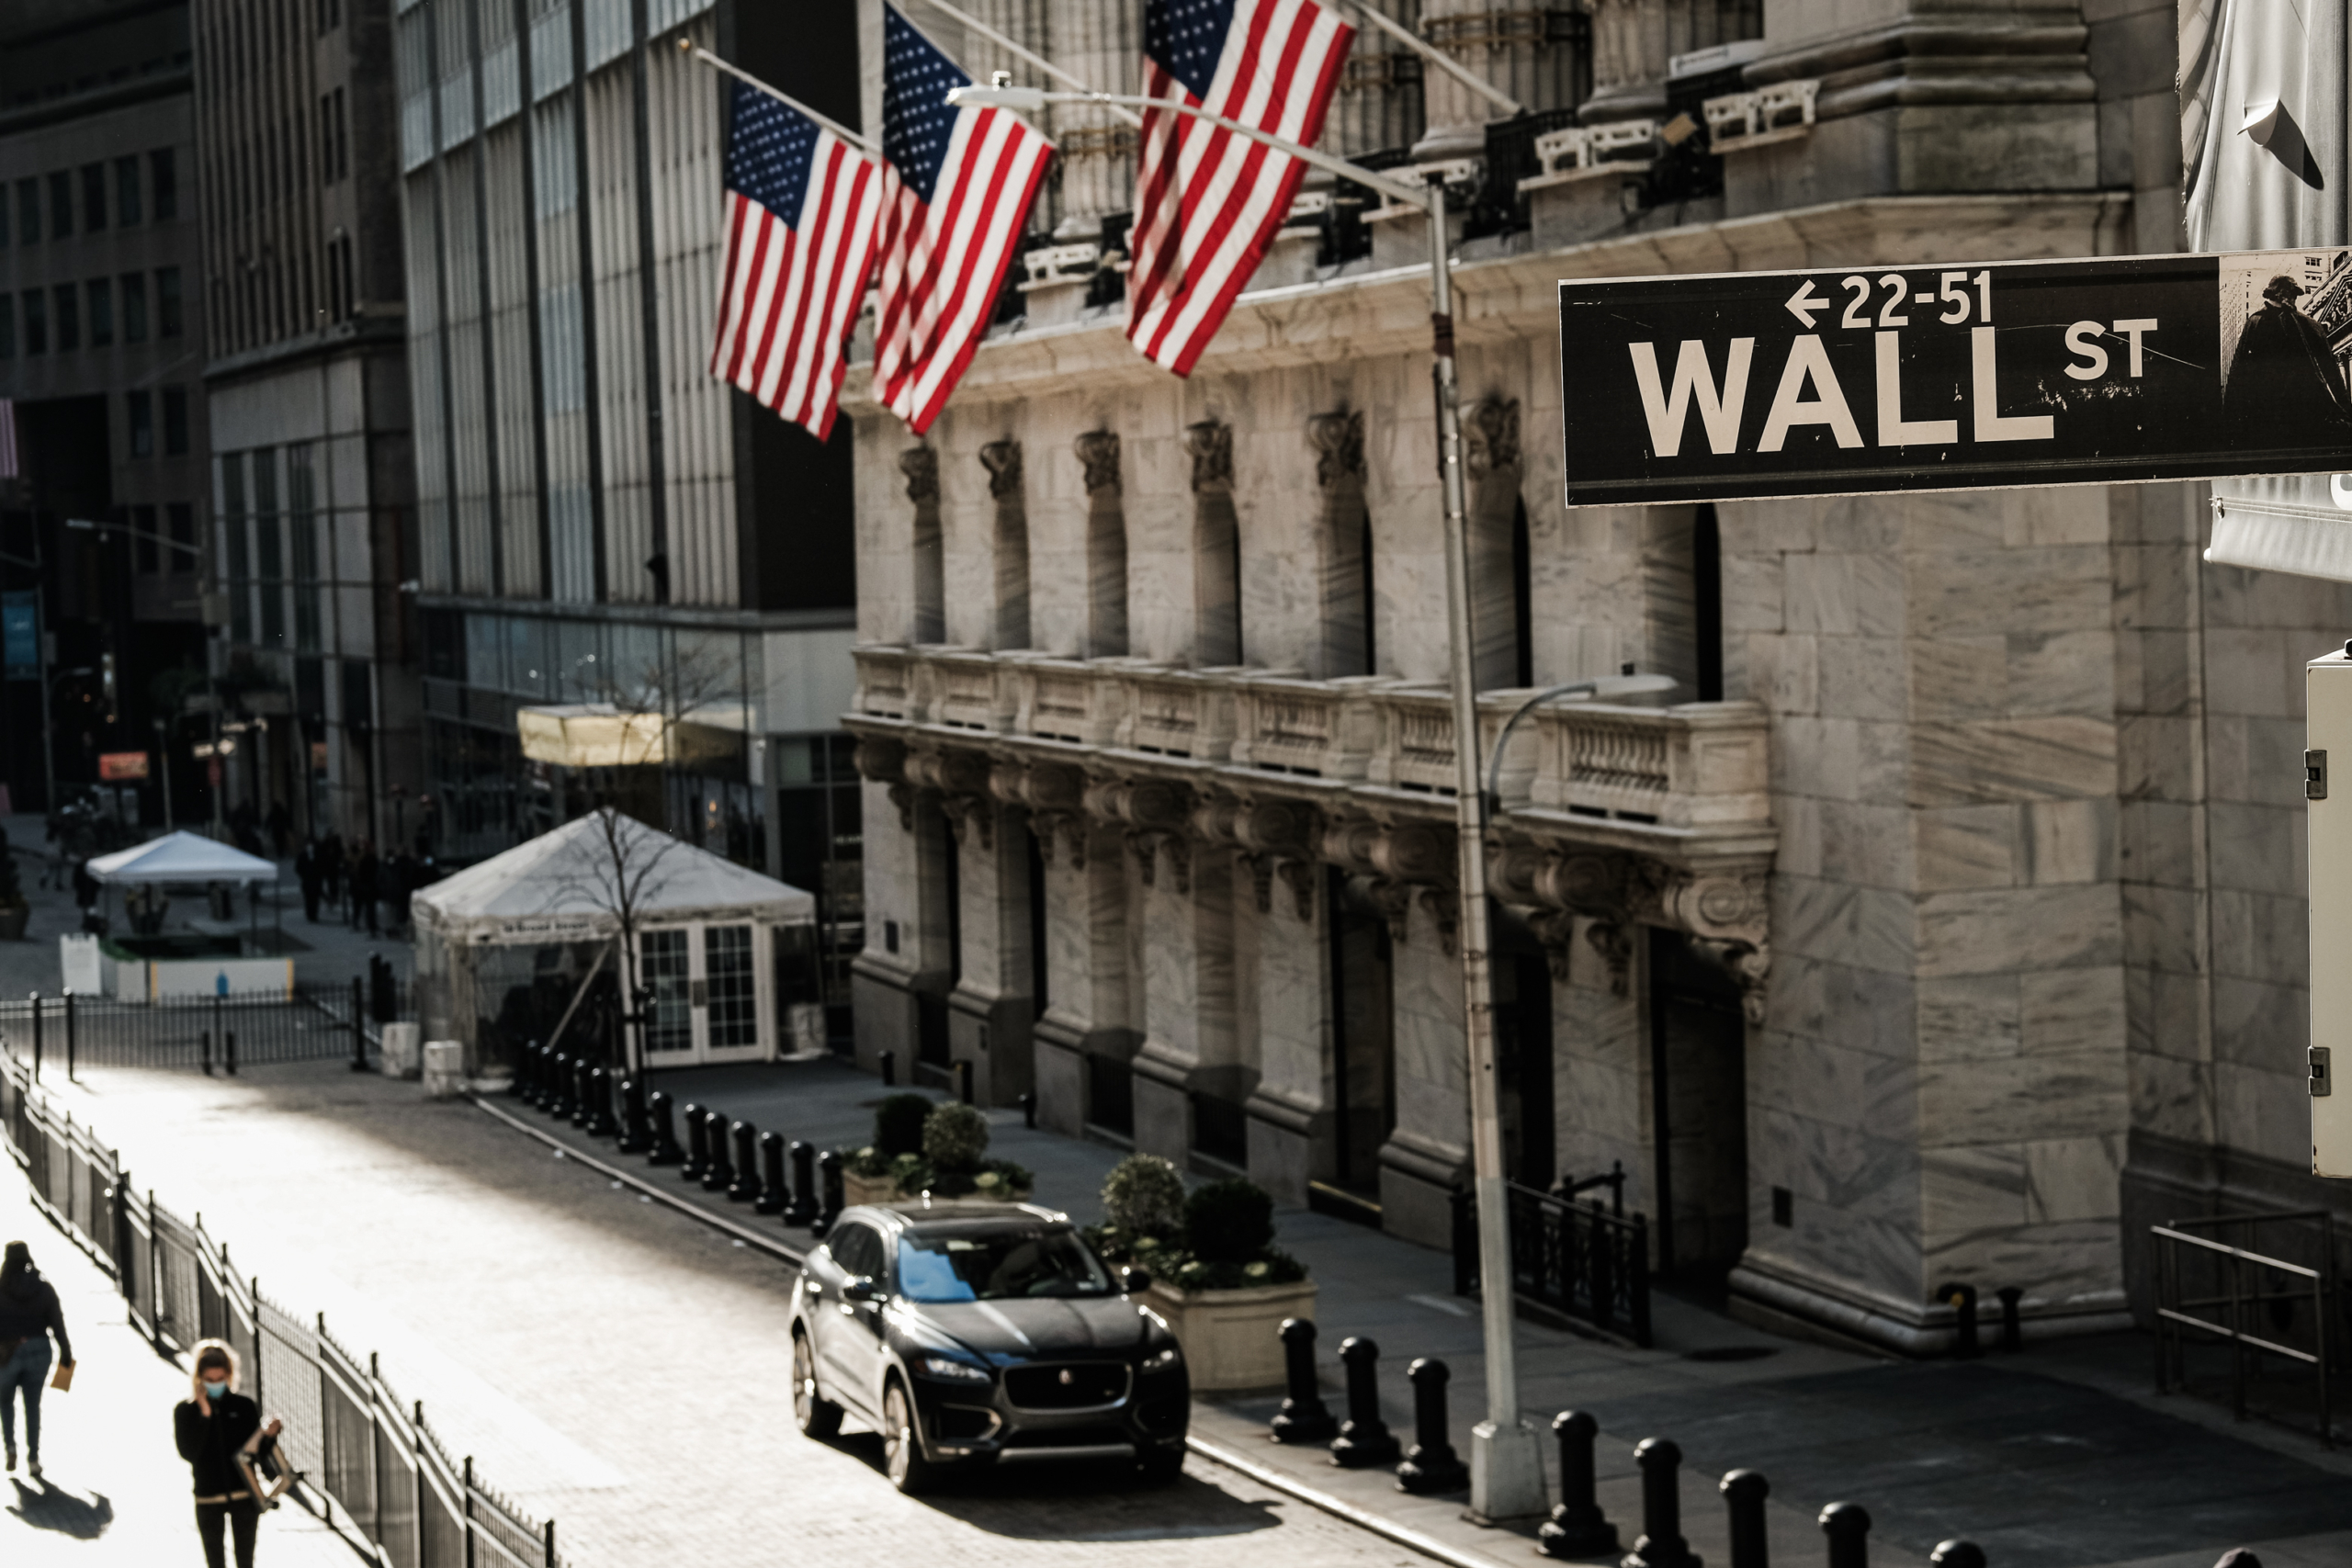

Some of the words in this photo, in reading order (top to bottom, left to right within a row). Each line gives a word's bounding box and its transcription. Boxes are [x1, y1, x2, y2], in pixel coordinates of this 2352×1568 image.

[1840, 270, 1993, 329] 22-51
[1628, 325, 2054, 457] WALL
[2064, 318, 2158, 381] ST
